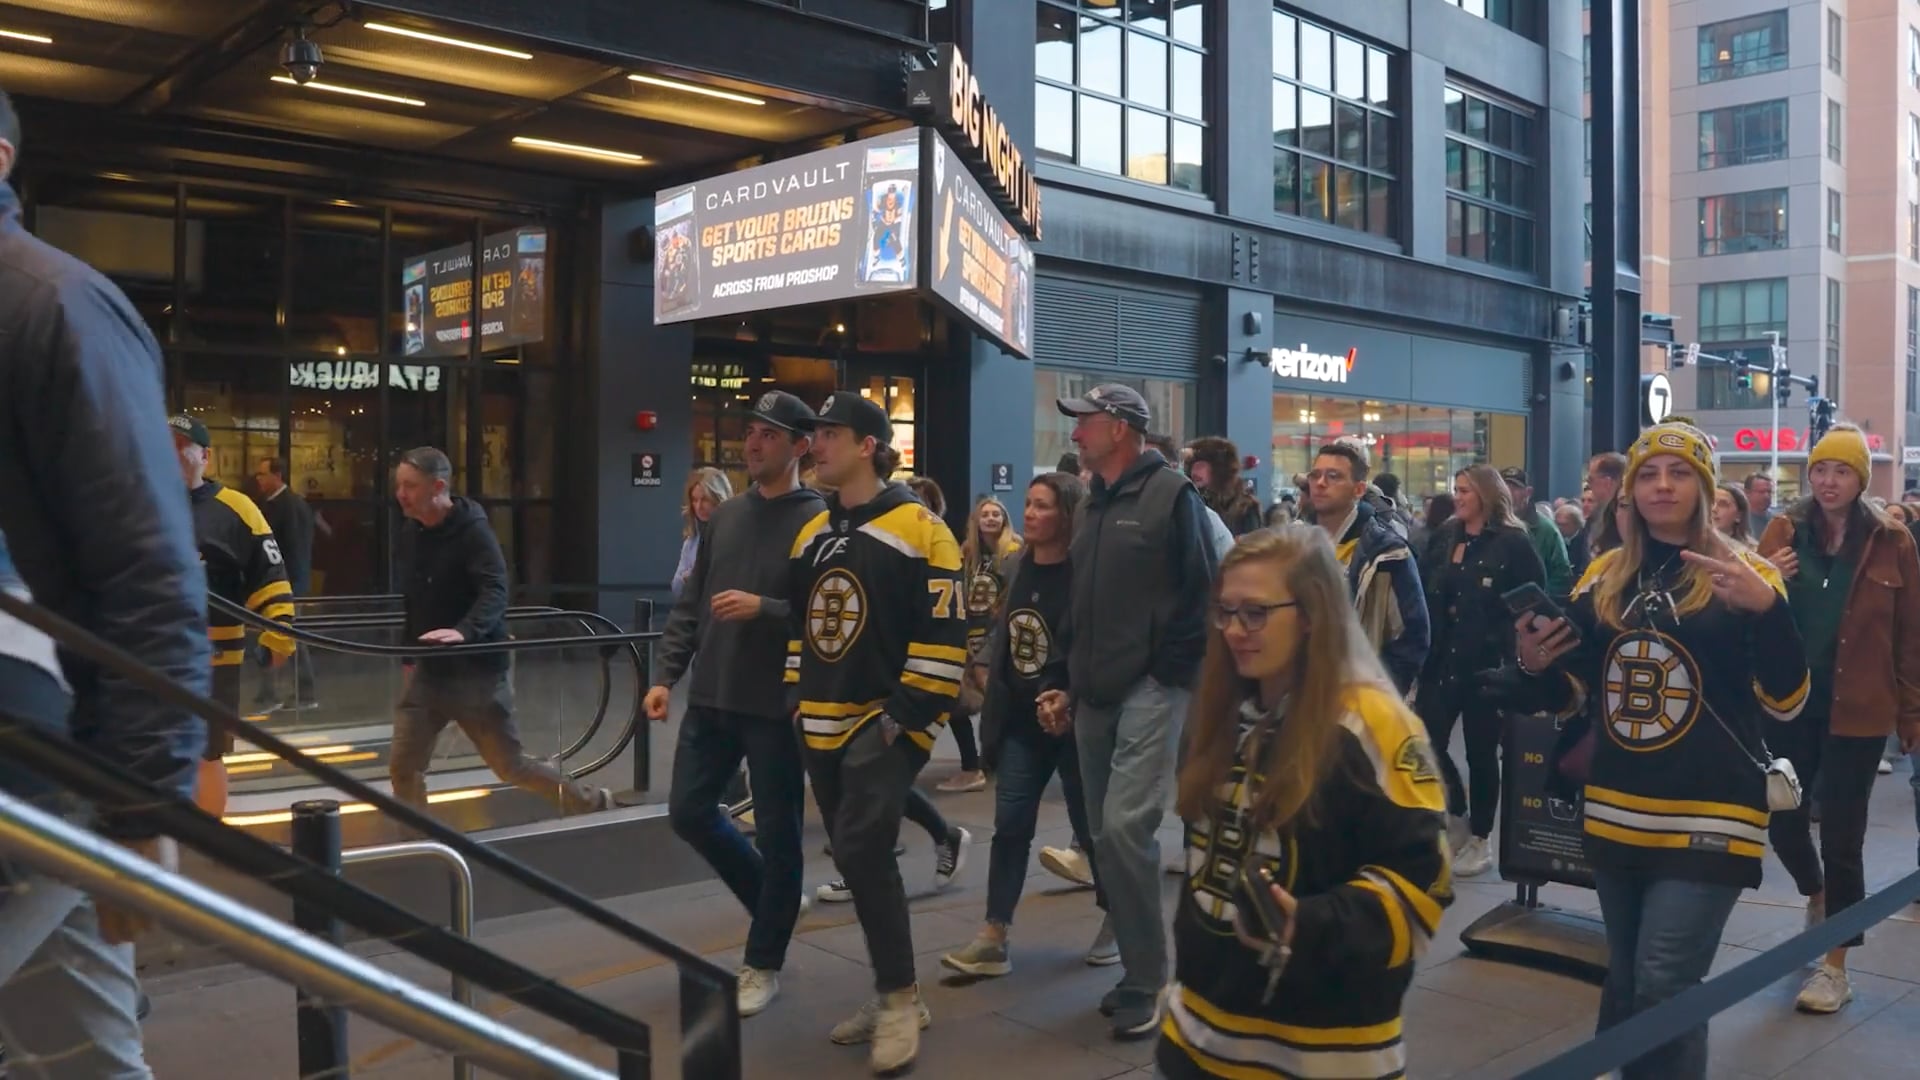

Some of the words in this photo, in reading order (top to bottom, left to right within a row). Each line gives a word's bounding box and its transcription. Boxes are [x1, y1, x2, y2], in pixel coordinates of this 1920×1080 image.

[952, 44, 981, 148] BIG
[982, 100, 1021, 208] NIGHT
[702, 222, 733, 248] GET
[735, 211, 780, 242] YOUR
[784, 196, 855, 235] BRUINS
[712, 234, 777, 268] SPORTS
[780, 223, 841, 255] CARDS
[712, 278, 753, 299] ACROSS
[754, 273, 785, 292] FROM
[786, 264, 839, 286] PROSHOP
[1272, 343, 1347, 383] verizon
[1734, 428, 1798, 451] CVS
[927, 578, 967, 620] 71
[1524, 752, 1544, 764] NO
[1522, 796, 1543, 809] NO
